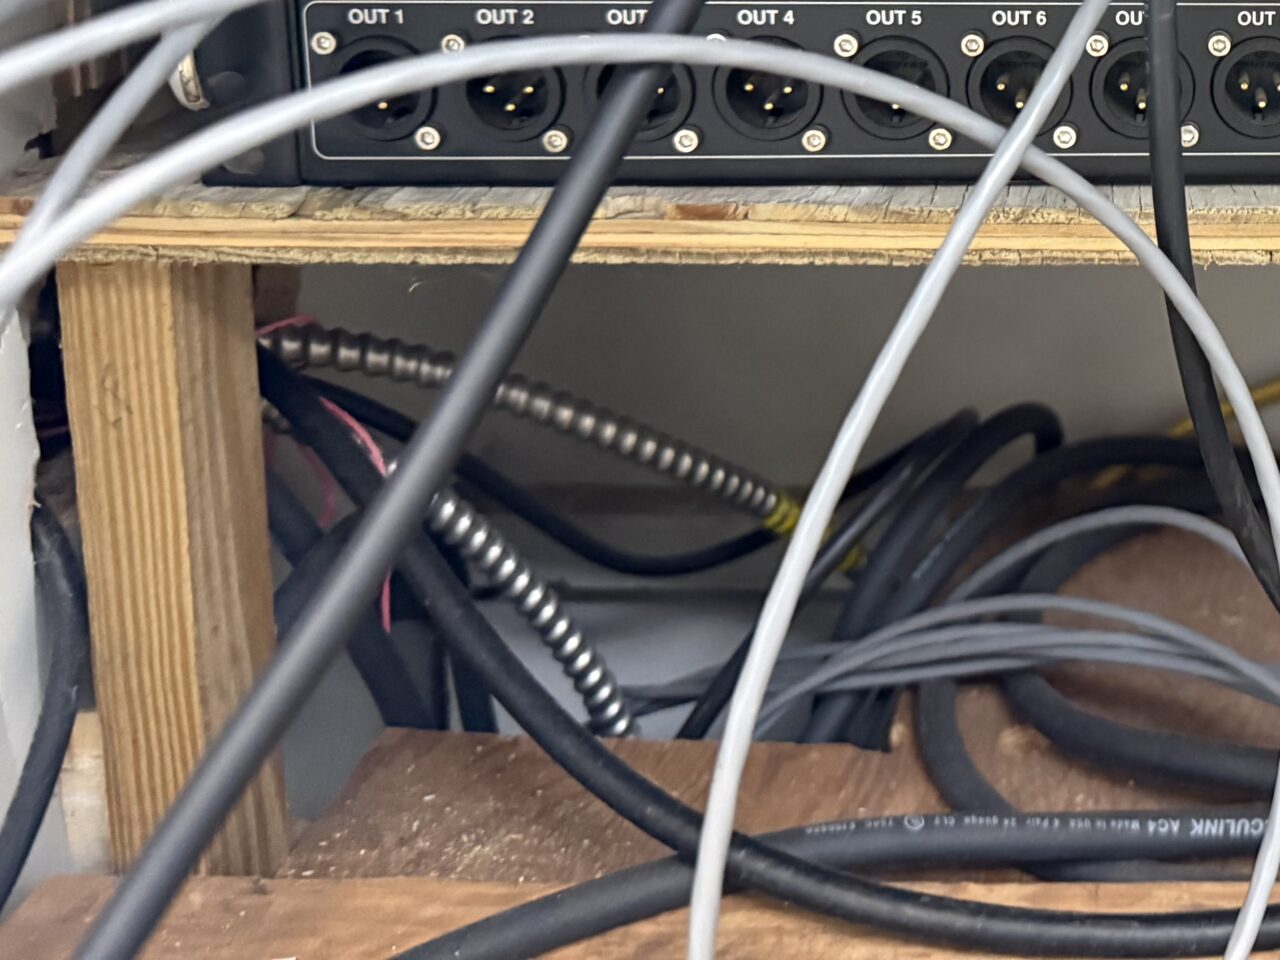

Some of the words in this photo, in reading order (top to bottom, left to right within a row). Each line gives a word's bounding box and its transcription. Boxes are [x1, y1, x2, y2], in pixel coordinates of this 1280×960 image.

[347, 8, 390, 25] OUT
[394, 9, 404, 24] 1
[475, 8, 519, 25] OUT
[522, 8, 535, 25] 2
[606, 9, 648, 25] OUT
[736, 9, 779, 26] OUT
[782, 9, 795, 25] 4
[865, 9, 907, 26] OUT
[911, 9, 922, 26] 5
[991, 9, 1032, 26] OUT
[1035, 10, 1047, 26] 6
[1115, 10, 1144, 26] OU
[1237, 10, 1277, 26] OUT
[1147, 817, 1181, 836] AC4
